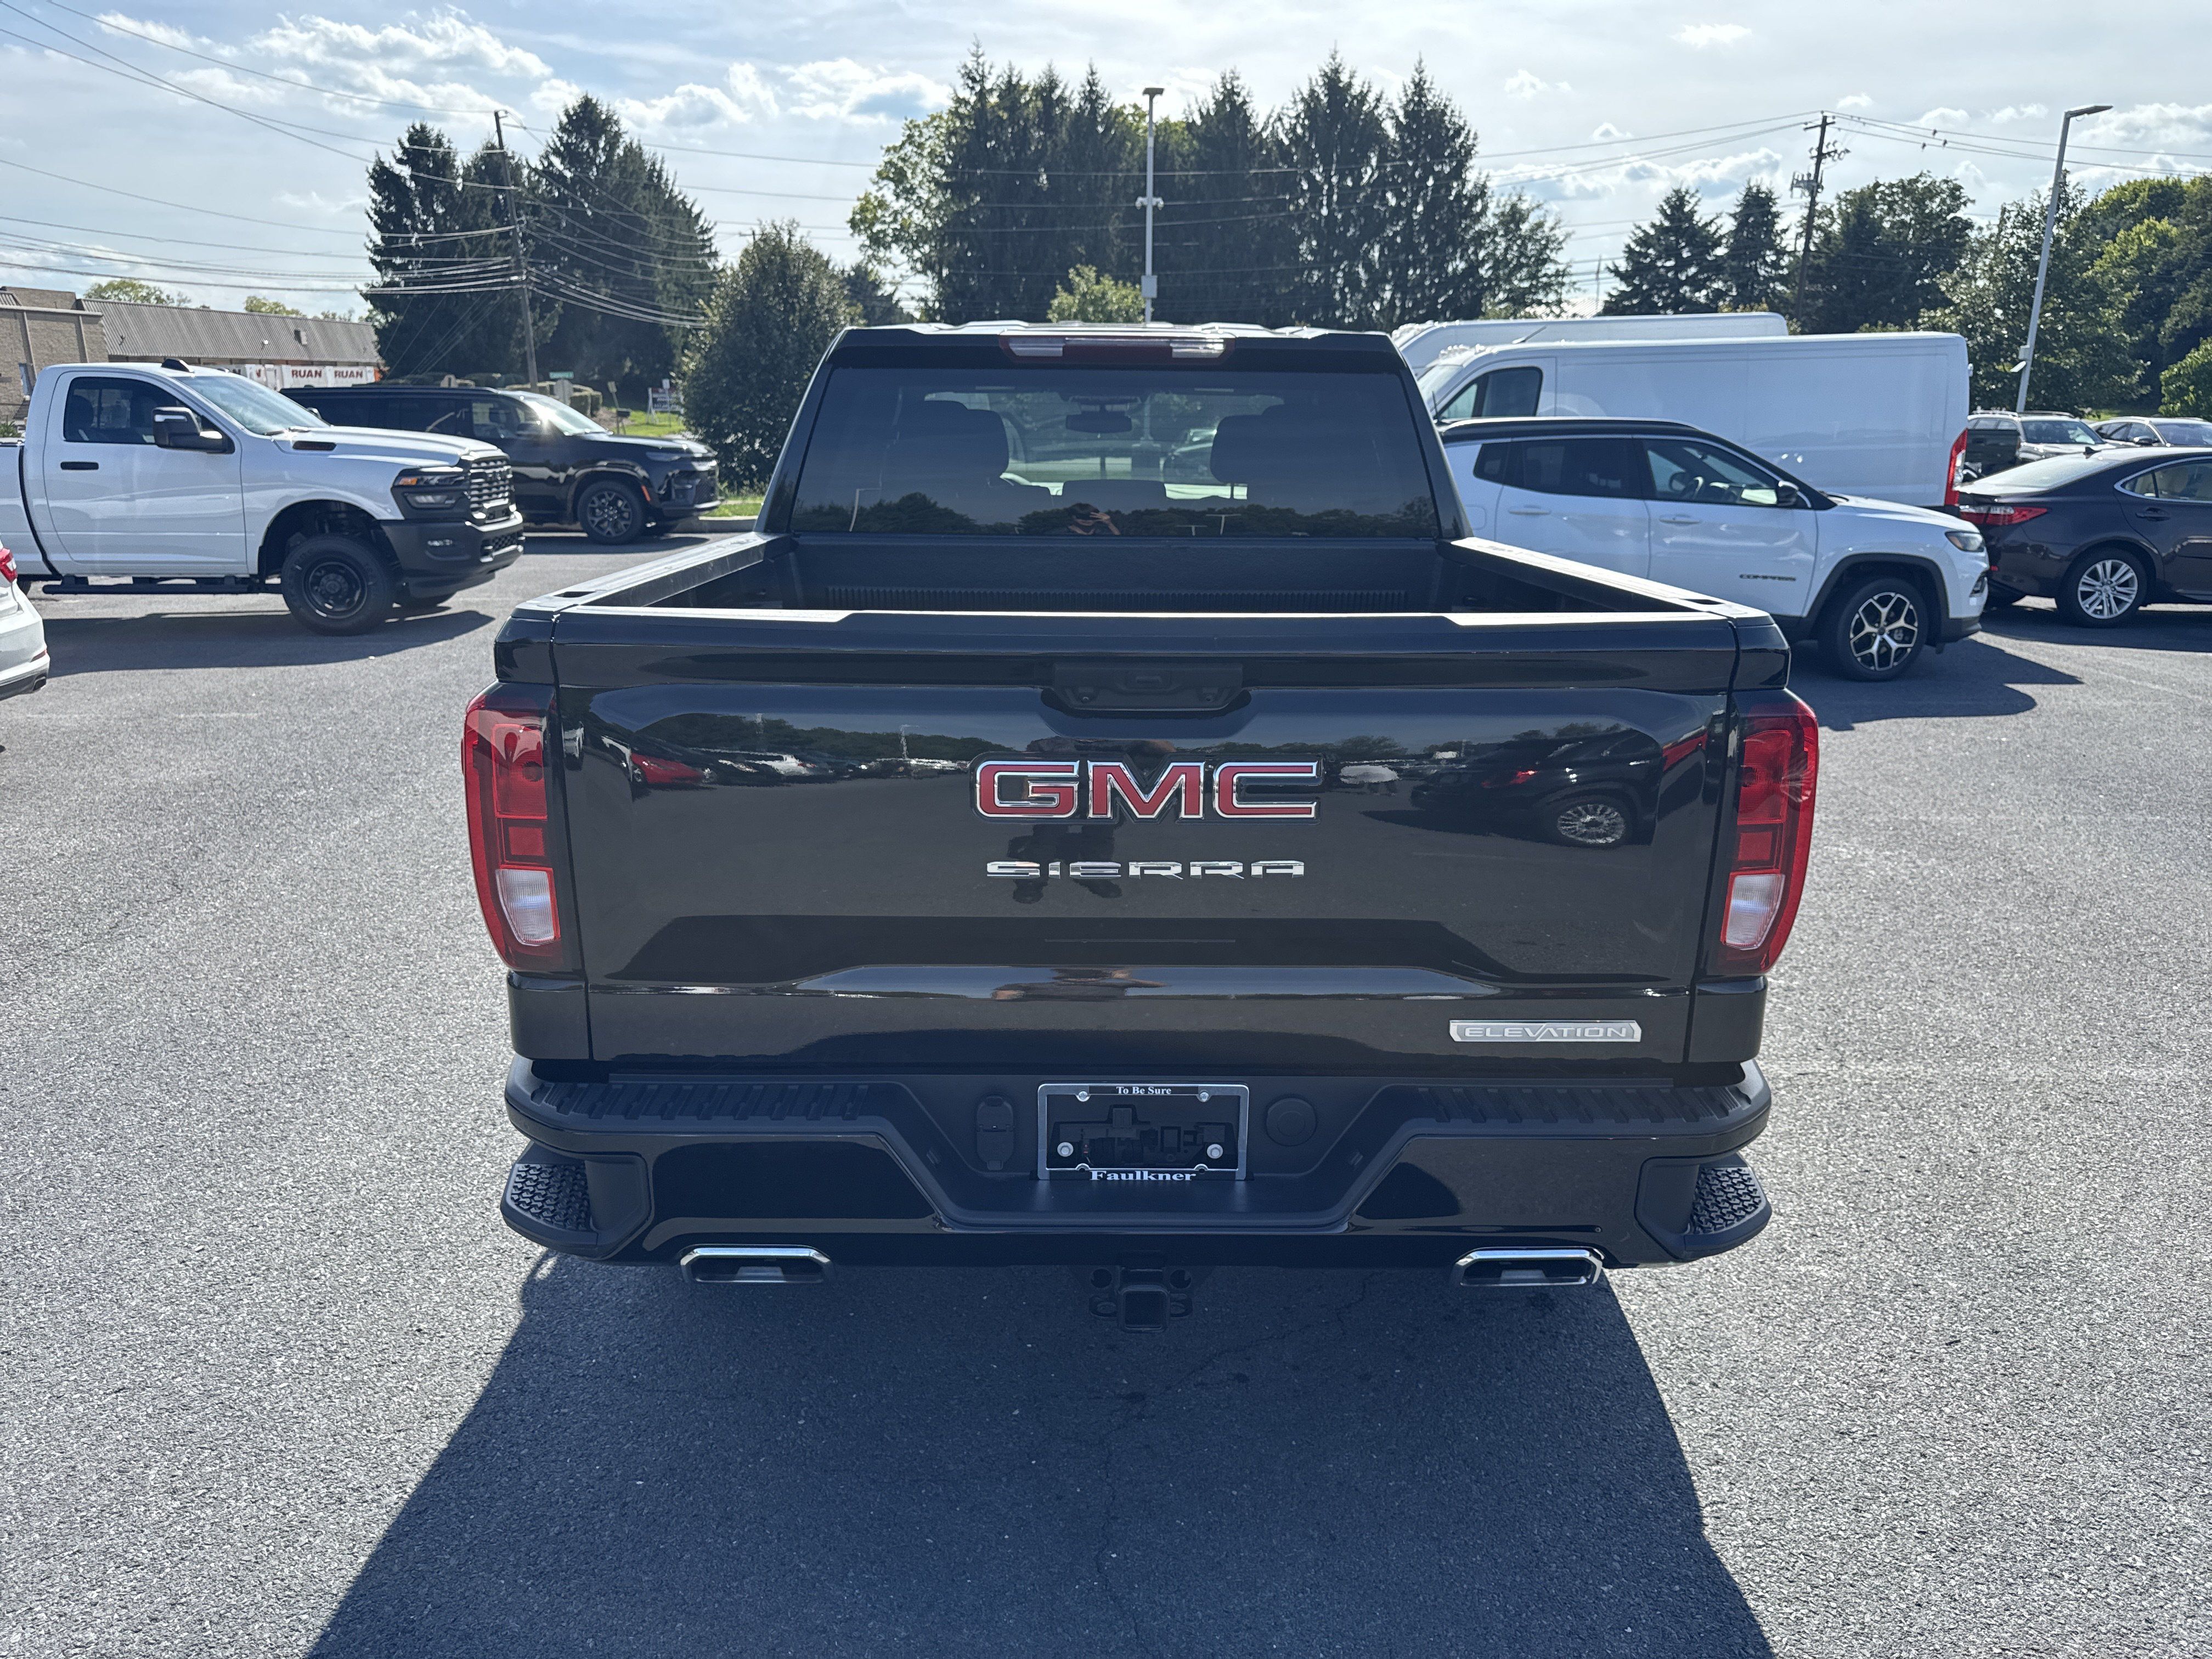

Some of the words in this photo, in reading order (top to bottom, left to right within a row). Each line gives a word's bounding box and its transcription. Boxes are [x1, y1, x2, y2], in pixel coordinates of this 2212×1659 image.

[291, 369, 323, 379] RUAN
[334, 369, 363, 379] RUAN
[976, 760, 1317, 819] GMC
[987, 860, 1305, 879] SIERRA
[1464, 1026, 1626, 1037] ELEVATION
[1116, 1086, 1129, 1094] To
[1132, 1086, 1145, 1094] Be
[1148, 1086, 1172, 1094] Sure
[1090, 1170, 1196, 1181] Faulkner
